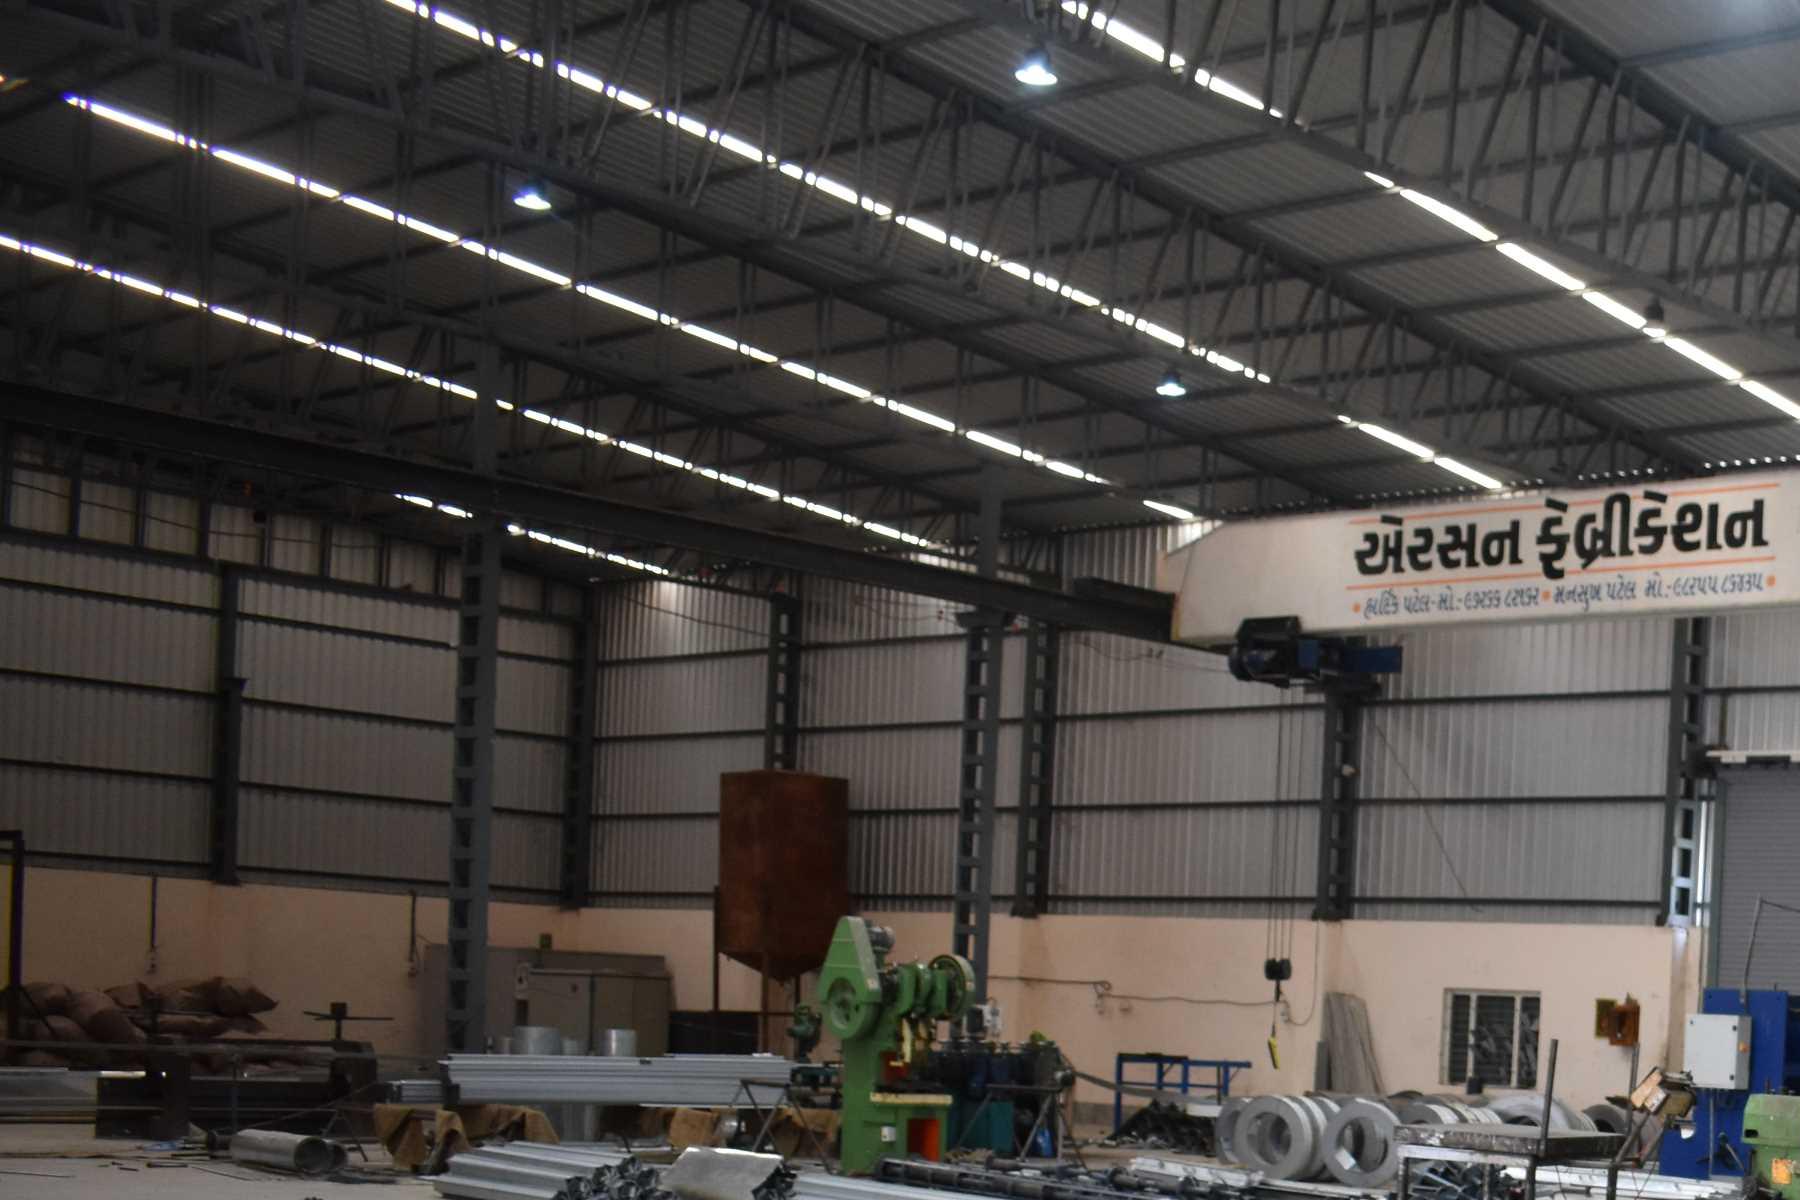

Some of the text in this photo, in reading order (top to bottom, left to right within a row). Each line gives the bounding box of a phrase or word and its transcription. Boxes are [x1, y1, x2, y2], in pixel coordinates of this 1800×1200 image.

[1354, 489, 1769, 580] એરસન ફેબ્રીકેશન
[1606, 574, 1637, 601] પટેલ
